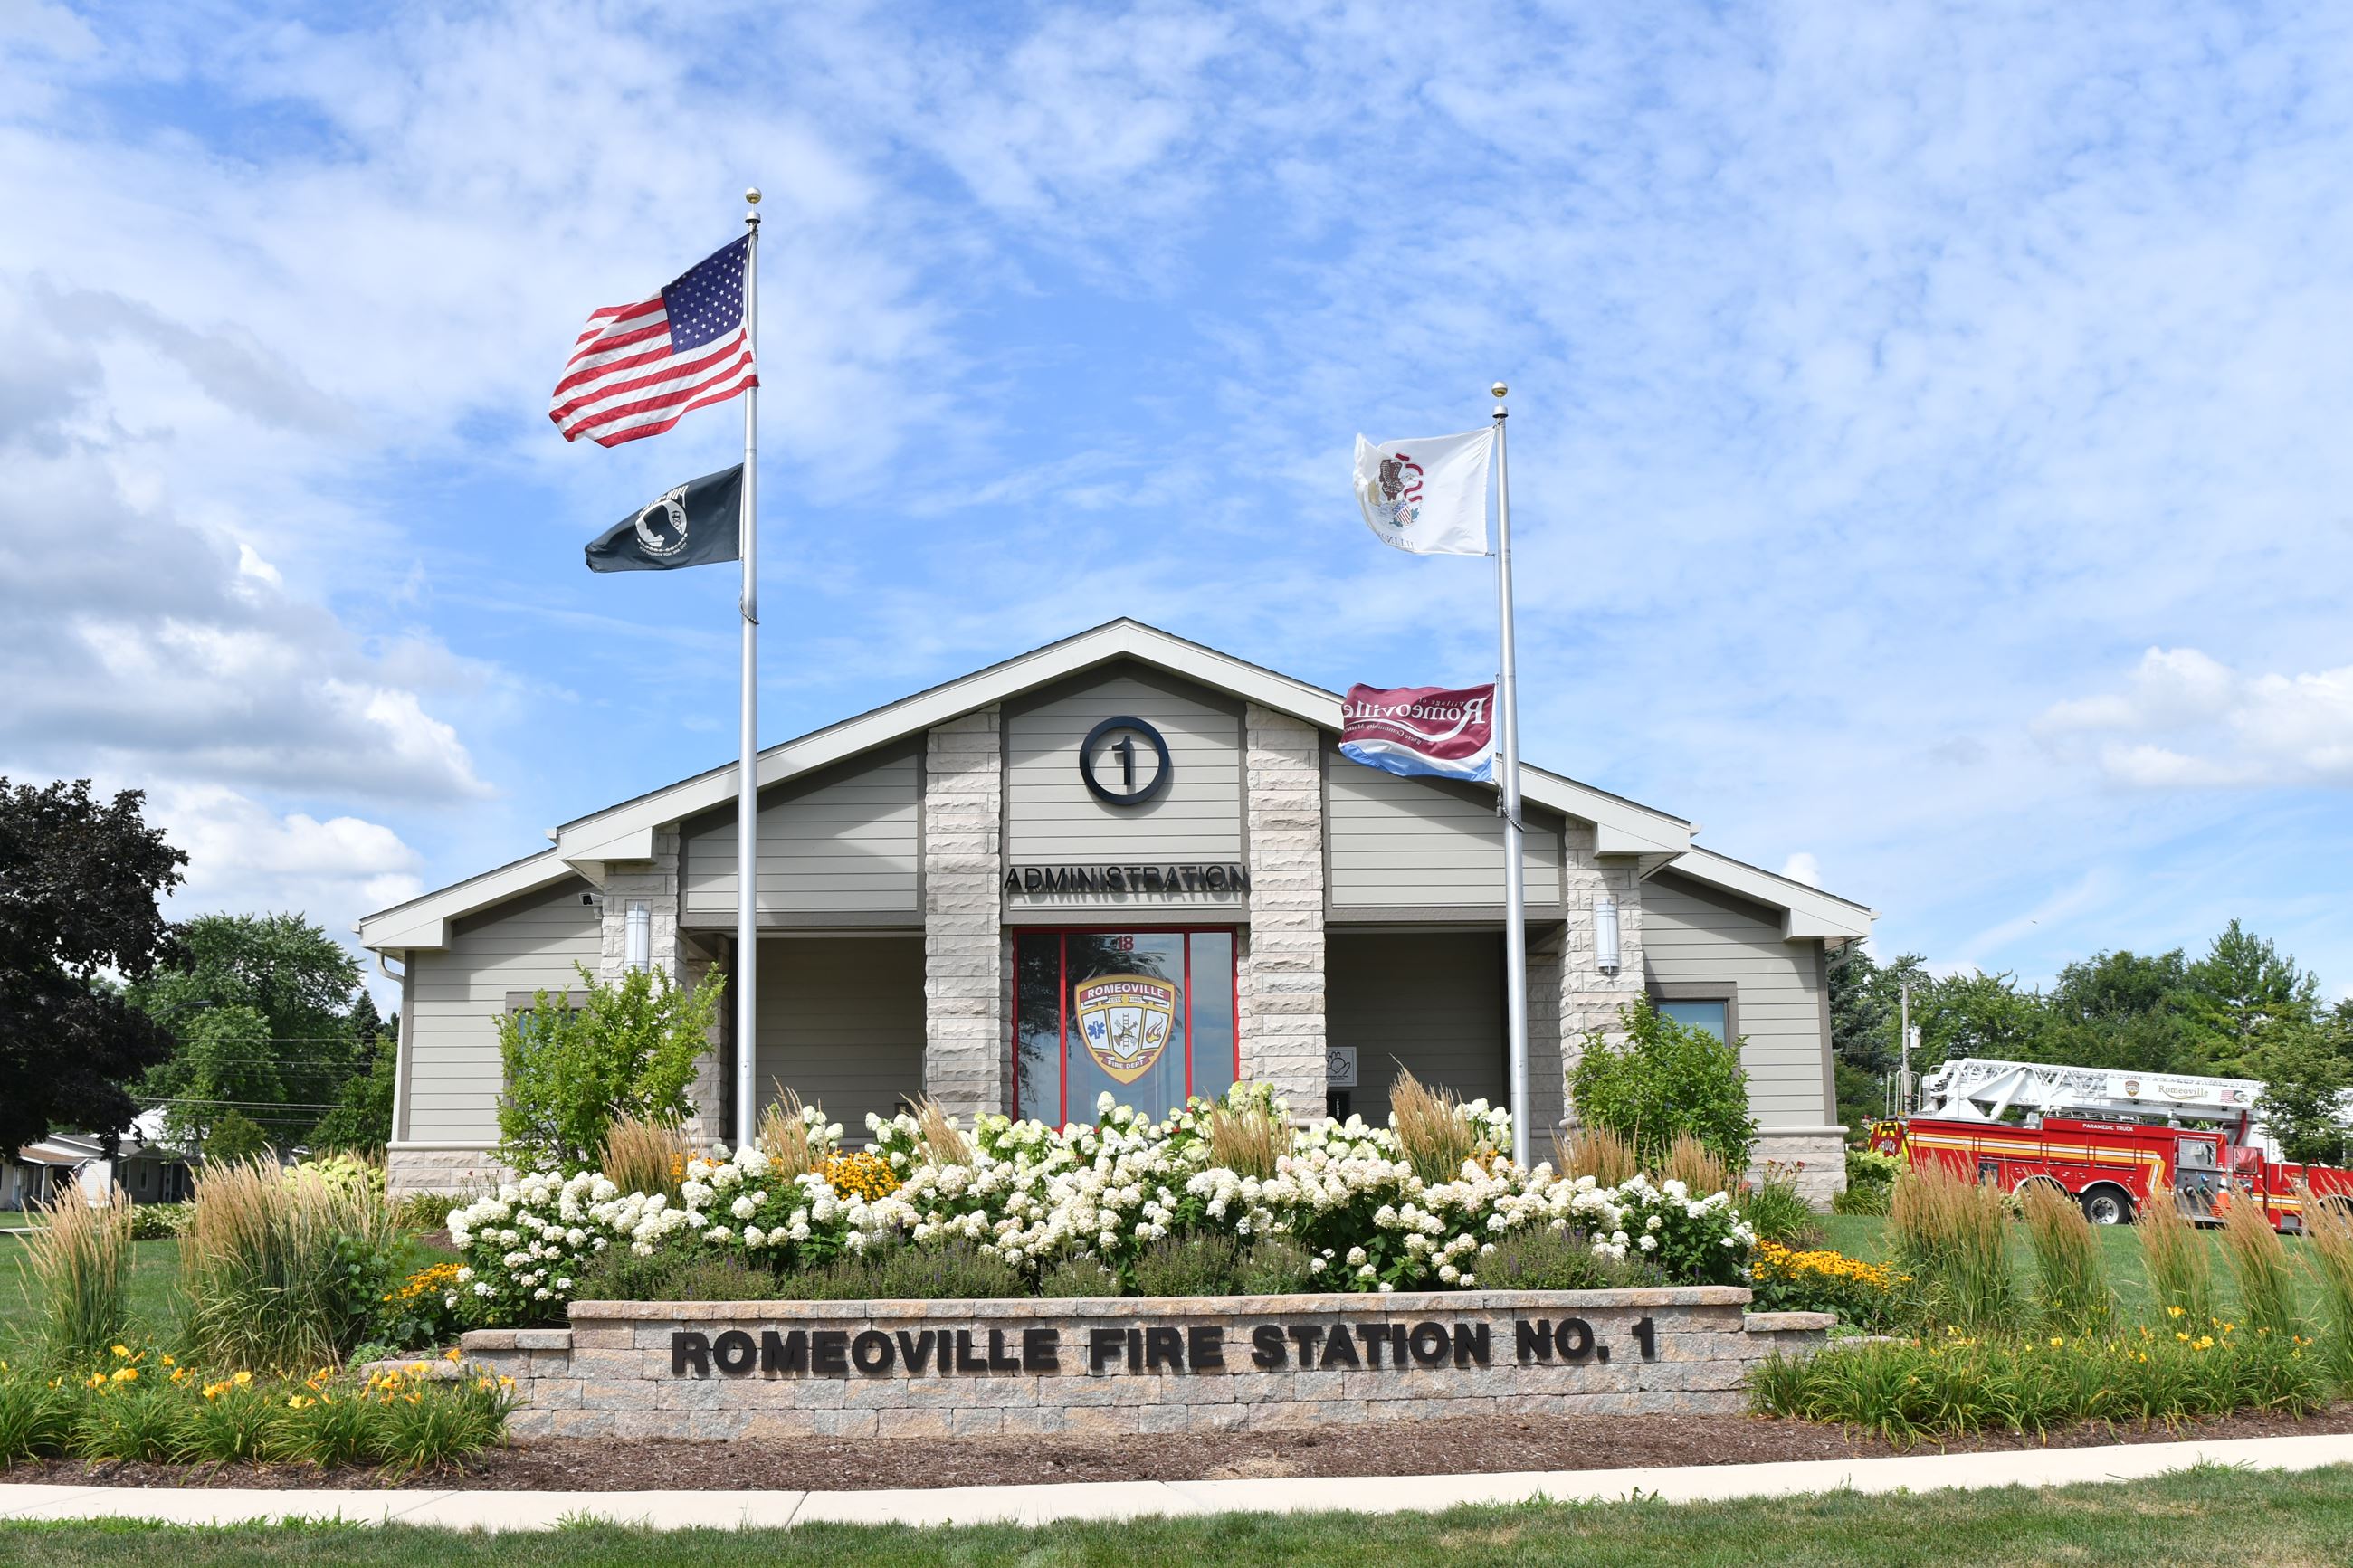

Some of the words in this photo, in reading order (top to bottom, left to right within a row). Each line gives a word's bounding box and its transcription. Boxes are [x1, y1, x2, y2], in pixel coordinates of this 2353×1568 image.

[1111, 735, 1131, 785] 1
[1004, 865, 1250, 893] ADMINISTRATION
[1116, 936, 1134, 951] 18
[1087, 984, 1165, 998] ROMEOVILLE
[1107, 1060, 1124, 1069] FIRE
[1126, 1060, 1144, 1069] DEPT
[2158, 1085, 2208, 1098] Romeoville
[672, 1328, 1058, 1373] ROMEOVILLE
[1090, 1326, 1224, 1371] FIRE
[1252, 1322, 1490, 1367] STATION
[1515, 1317, 1609, 1360] NO.
[1632, 1317, 1654, 1358] 1
